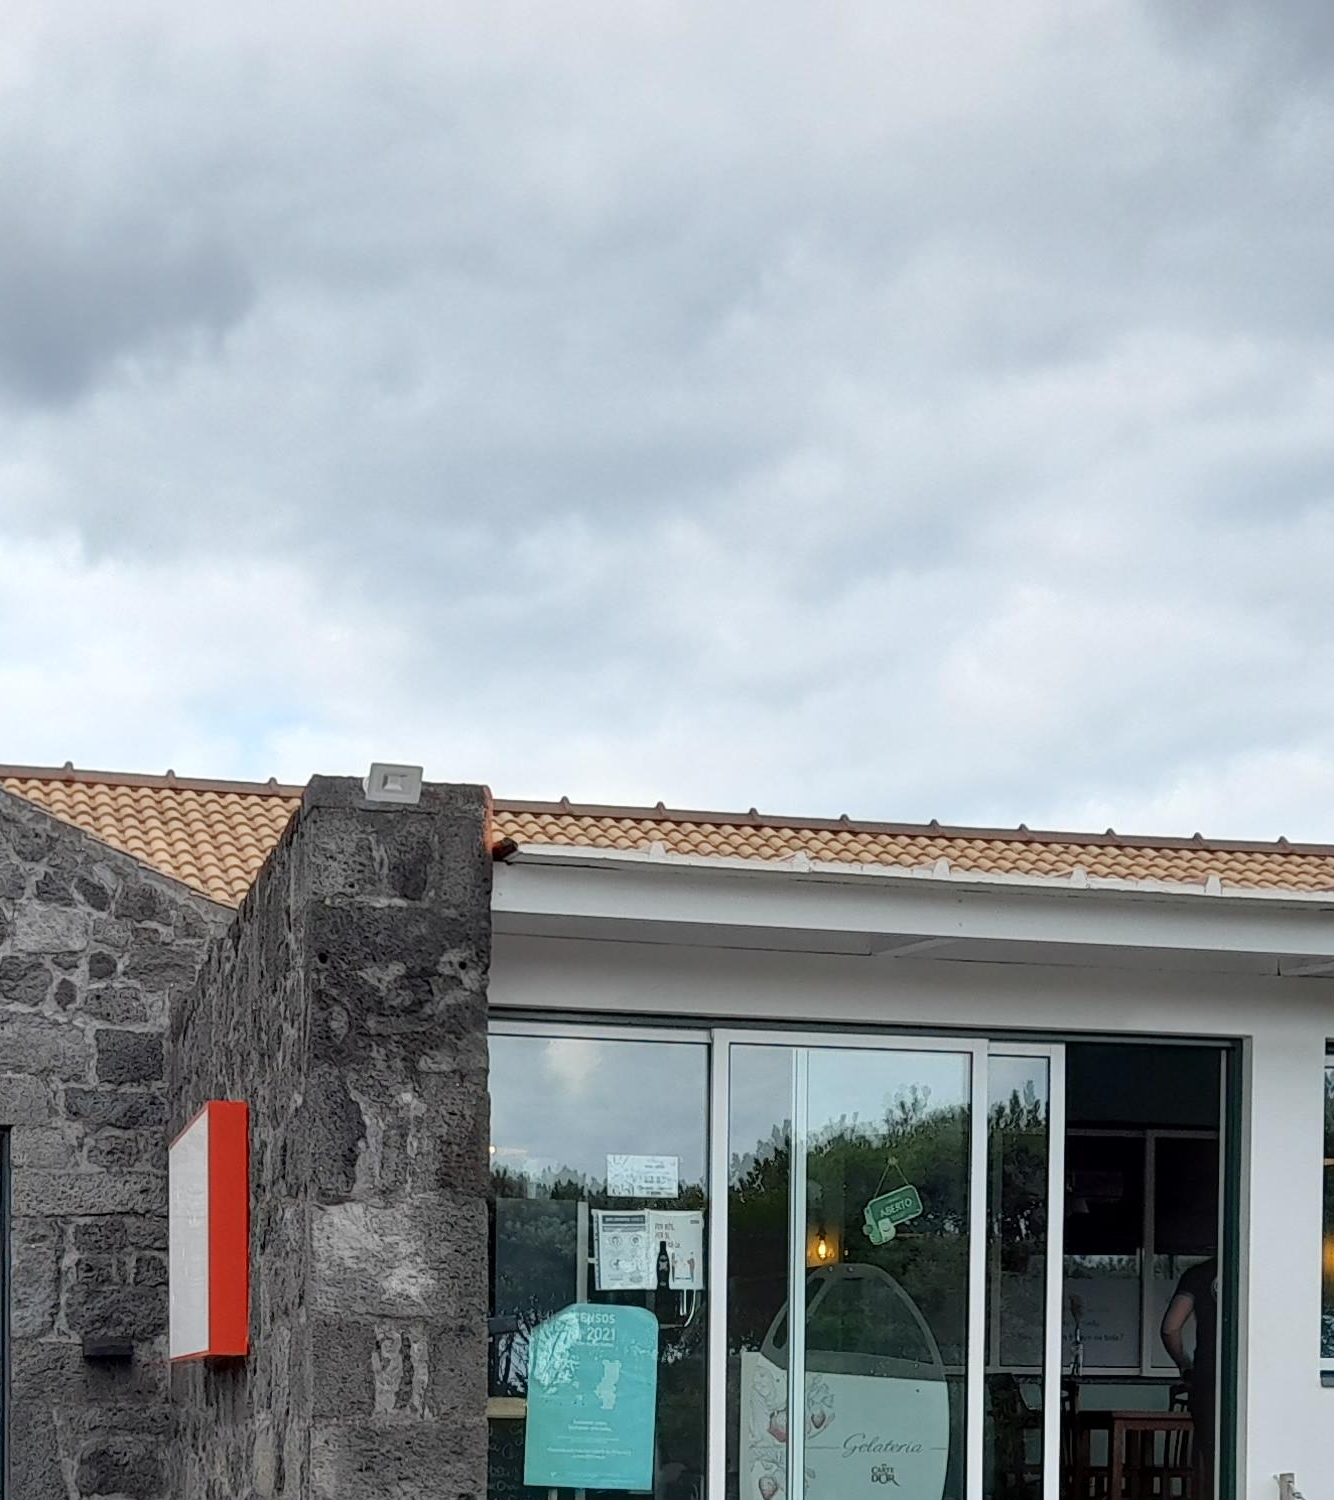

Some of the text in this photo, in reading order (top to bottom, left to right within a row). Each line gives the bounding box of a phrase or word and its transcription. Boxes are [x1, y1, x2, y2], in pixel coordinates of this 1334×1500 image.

[575, 1312, 616, 1324] CENSOS
[587, 1326, 616, 1341] 2021
[841, 1432, 923, 1458] Gelateria
